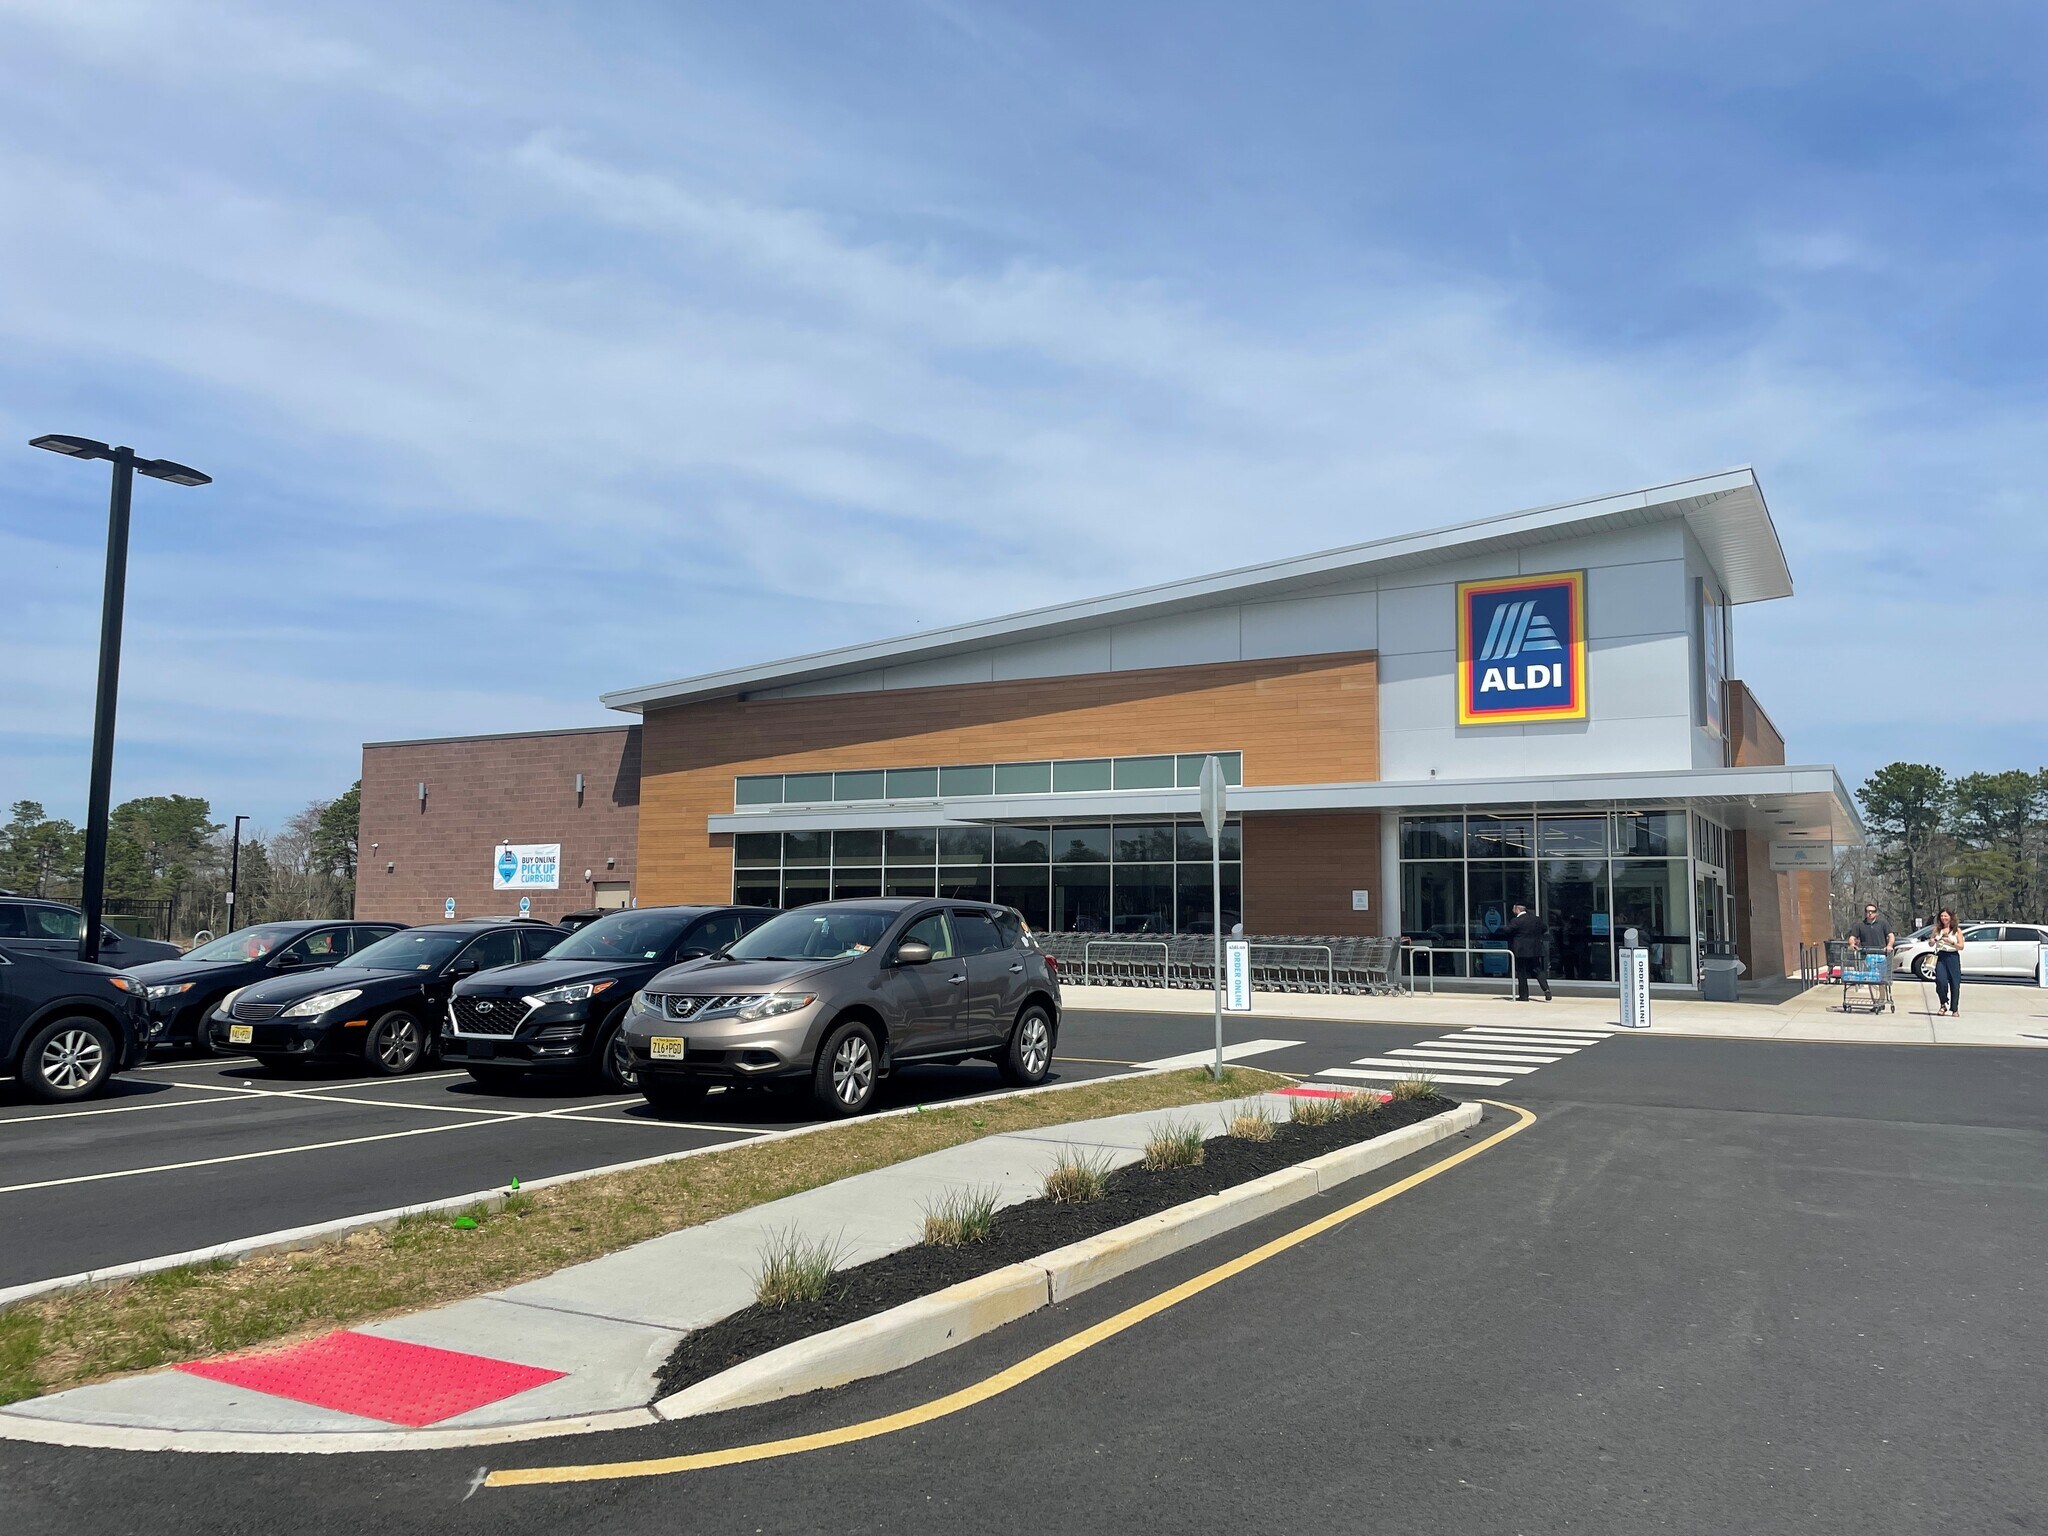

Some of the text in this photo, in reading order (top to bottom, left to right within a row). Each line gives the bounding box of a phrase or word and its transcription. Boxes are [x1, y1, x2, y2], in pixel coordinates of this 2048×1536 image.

[1480, 663, 1562, 692] ALDI
[522, 864, 556, 874] PICK UP
[521, 874, 555, 883] CURBSIDE
[1234, 951, 1242, 978] ORDER
